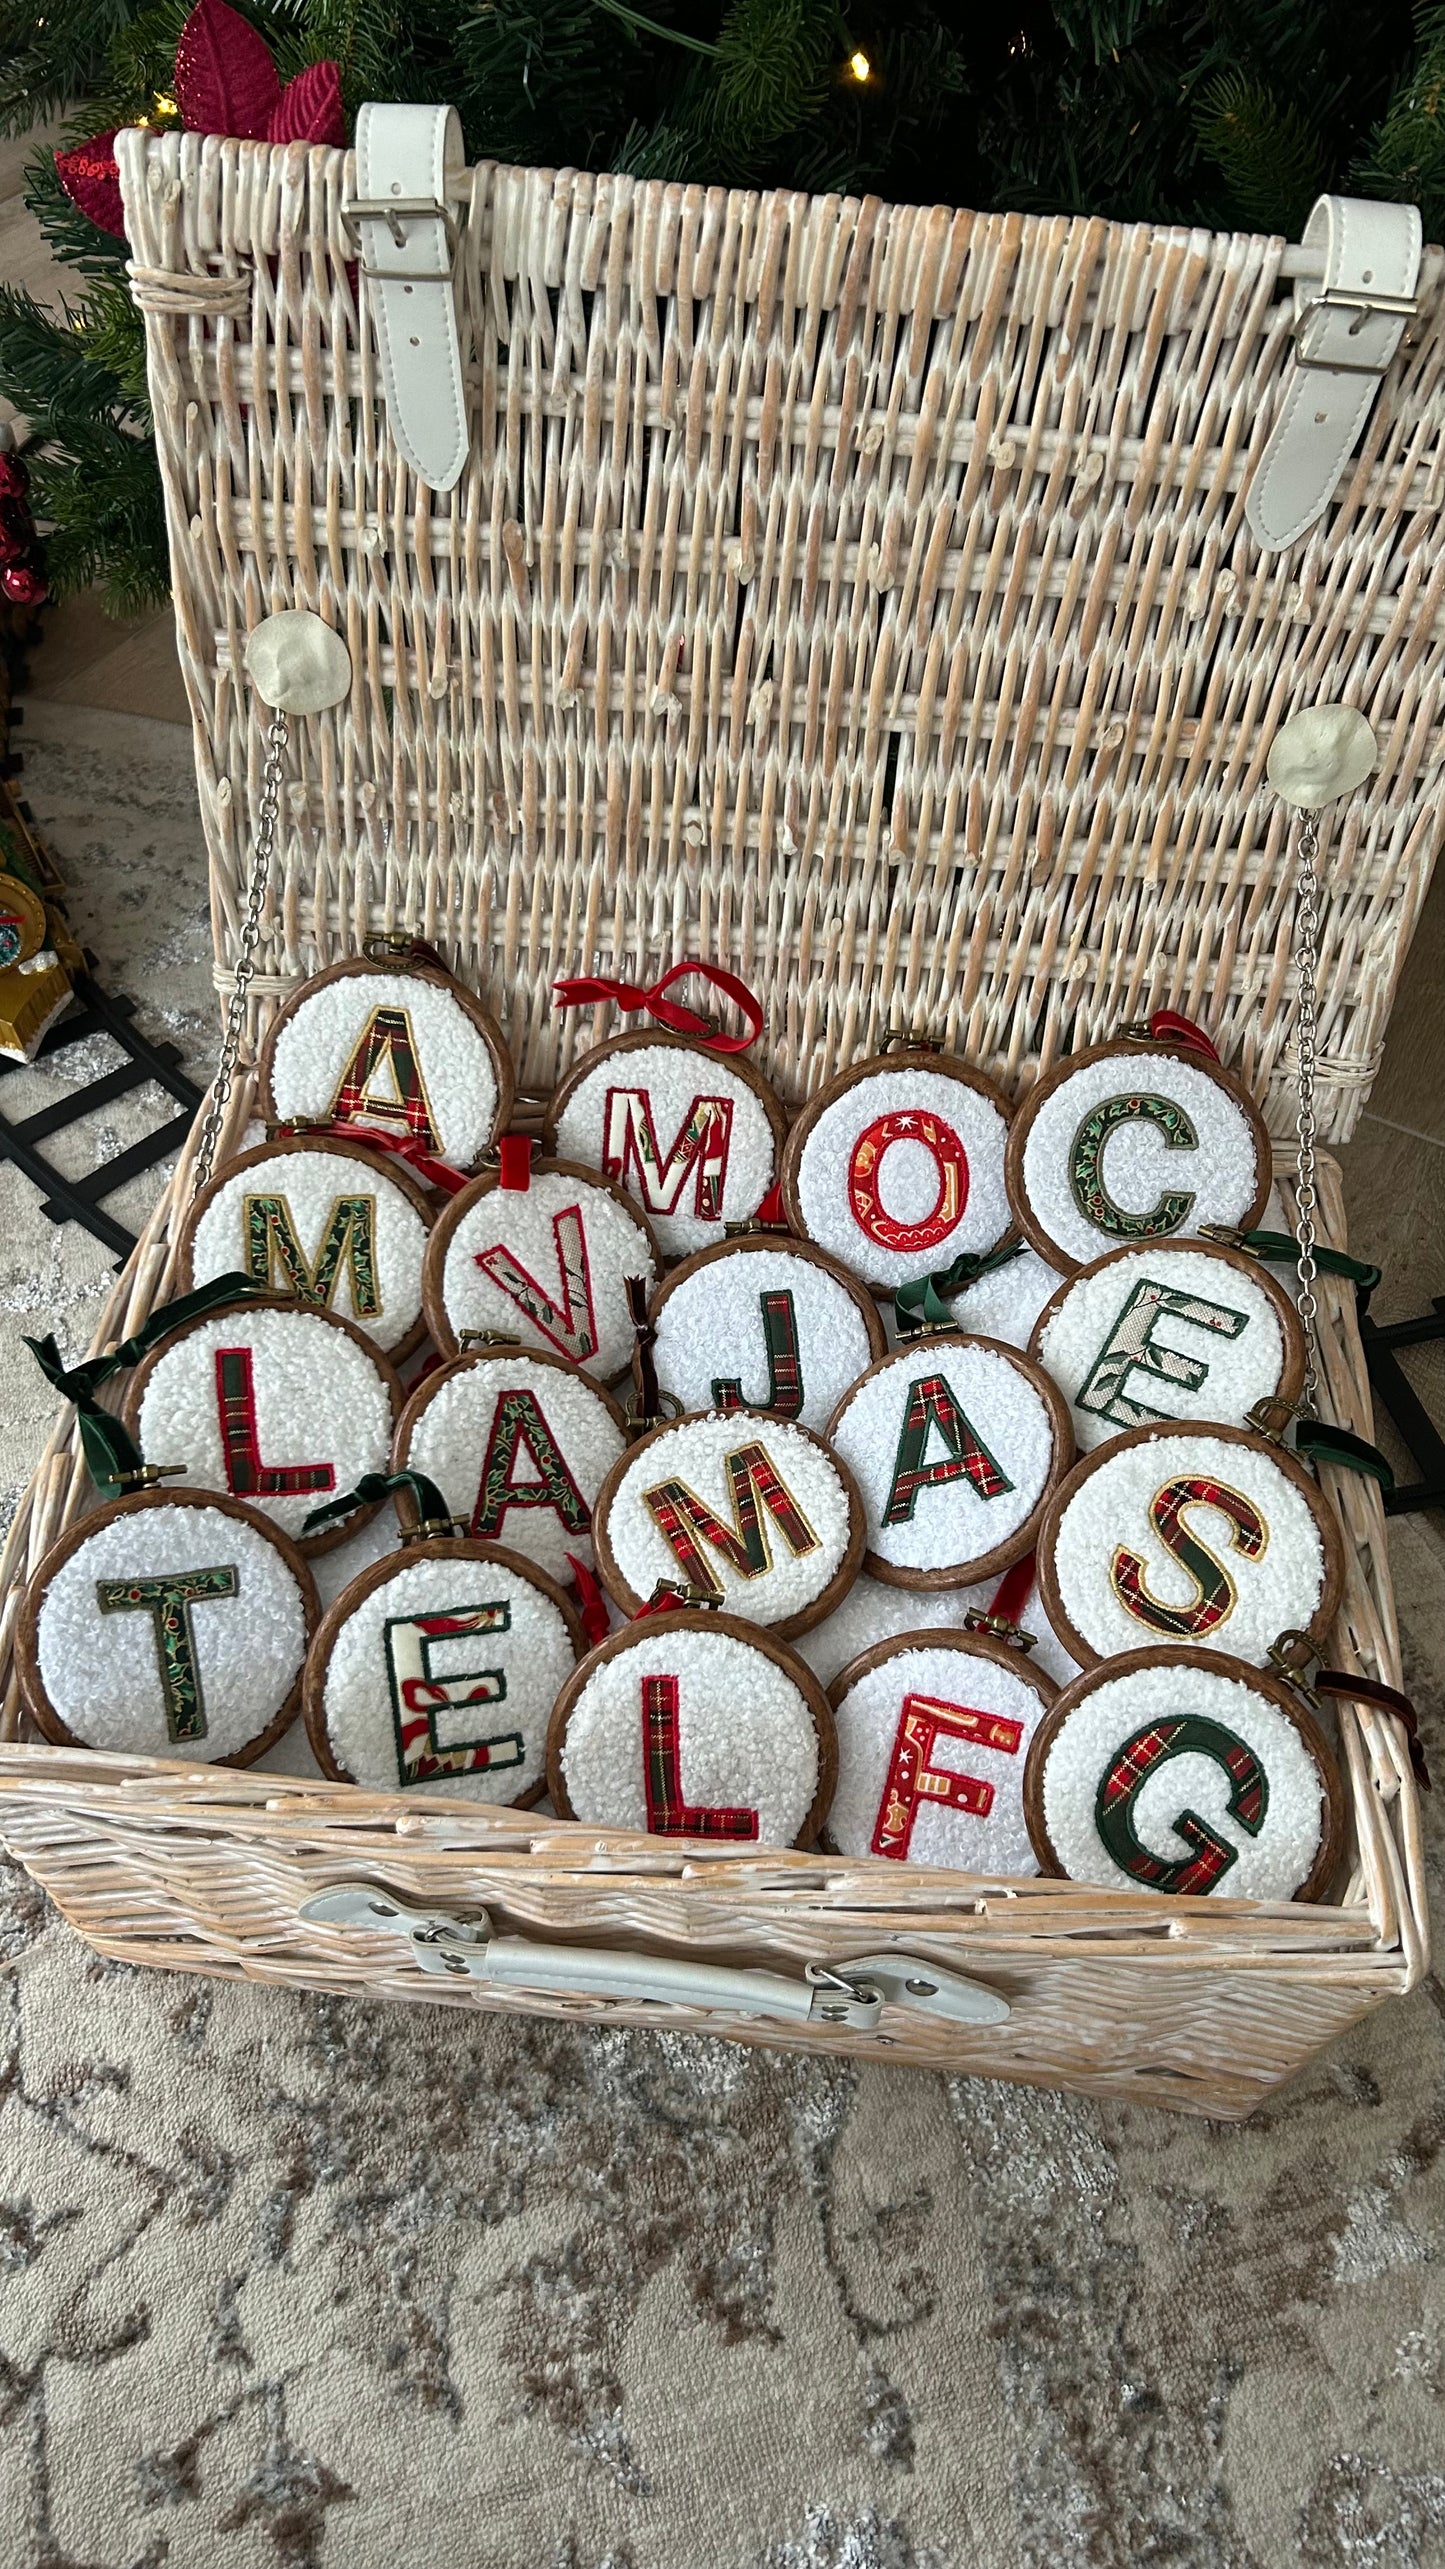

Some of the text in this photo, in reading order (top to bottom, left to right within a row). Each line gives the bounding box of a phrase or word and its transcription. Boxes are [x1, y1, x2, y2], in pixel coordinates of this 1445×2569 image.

[326, 1005, 445, 1156] A
[604, 1087, 733, 1221] M
[848, 1109, 970, 1252] O
[1068, 1092, 1198, 1240] C
[243, 1193, 383, 1319] M
[475, 1204, 598, 1364] V
[215, 1348, 336, 1497] L
[711, 1290, 801, 1420] J
[1075, 1278, 1250, 1430] E
[471, 1389, 593, 1539] A
[643, 1440, 823, 1594] M
[881, 1373, 1014, 1528] A
[1110, 1474, 1270, 1641] S
[97, 1564, 239, 1744] T
[384, 1600, 525, 1787] E
[642, 1675, 759, 1839] L
[872, 1693, 1024, 1861] F
[1096, 1714, 1269, 1896] G
